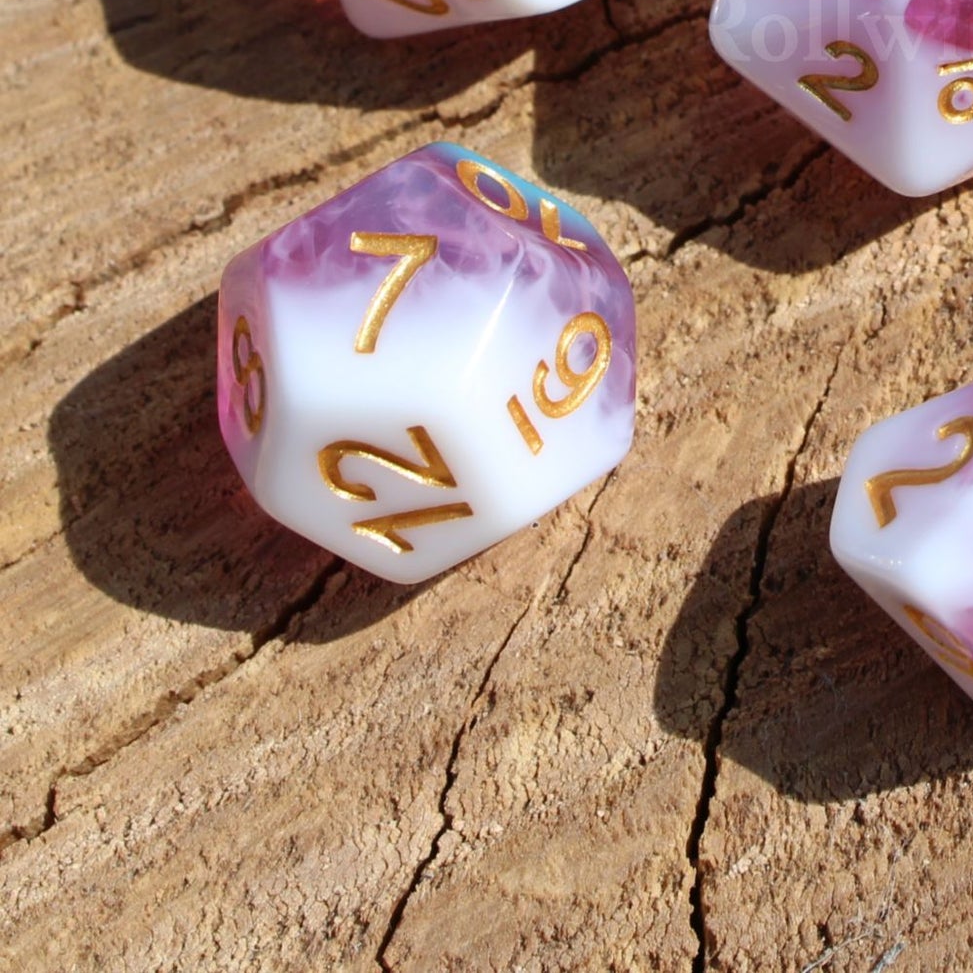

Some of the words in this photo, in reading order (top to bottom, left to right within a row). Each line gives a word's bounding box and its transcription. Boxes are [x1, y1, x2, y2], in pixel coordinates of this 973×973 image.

[797, 40, 880, 122] 2
[457, 159, 588, 251] 10
[349, 231, 438, 354] 7
[317, 425, 474, 554] 12
